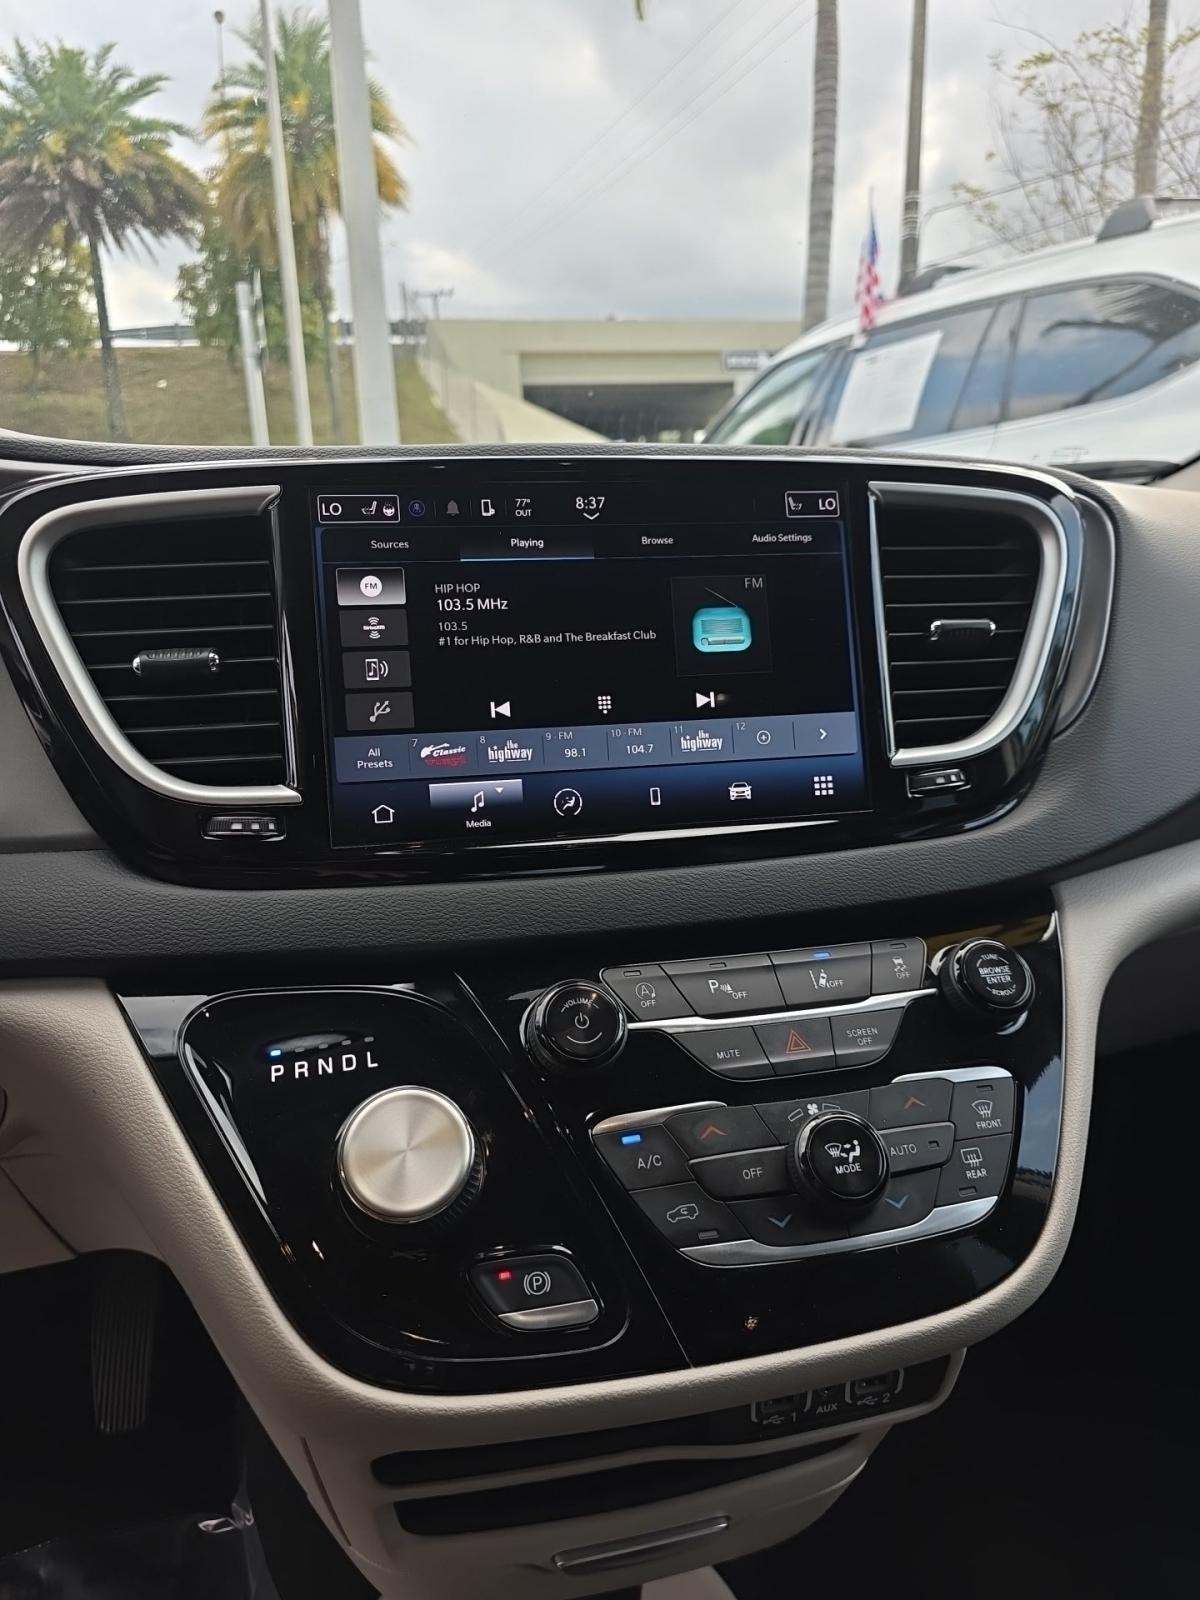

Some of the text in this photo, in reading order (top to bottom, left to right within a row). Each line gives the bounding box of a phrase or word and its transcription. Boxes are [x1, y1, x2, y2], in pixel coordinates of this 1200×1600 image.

[575, 496, 605, 509] 8:37
[818, 498, 836, 511] LO
[321, 502, 342, 516] LO
[515, 508, 532, 517] OUT
[510, 538, 544, 549] Playing
[641, 536, 674, 545] Browse
[752, 533, 813, 544] Audio Settings
[371, 540, 409, 549] Sources
[364, 582, 378, 590] FM
[434, 583, 481, 594] HIP HOP
[744, 578, 763, 589] FM
[437, 597, 509, 611] 103.5 MHz
[438, 621, 468, 631] 103.5
[439, 630, 657, 648] #1 for Hip Hop, R&B and The Breakfast Club
[674, 725, 684, 733] 11
[735, 722, 746, 731] 12
[545, 731, 573, 741] 9 FM
[611, 727, 642, 737] 10 FM
[411, 738, 418, 748] 7
[480, 736, 486, 744] 8
[507, 740, 518, 750] the
[680, 735, 723, 752] highway
[367, 748, 381, 757] All
[433, 745, 466, 757] Classic
[488, 746, 533, 762] highway
[564, 748, 587, 758] 98.1
[626, 744, 654, 754] 104.7
[357, 759, 393, 769] Presets
[466, 819, 492, 828] Media
[895, 970, 911, 980] OFF
[978, 965, 1011, 975] BROWSE
[829, 979, 845, 988] OFF
[986, 975, 1012, 985] ENTER
[731, 991, 749, 1000] OFF
[640, 999, 657, 1008] OFF
[846, 1027, 878, 1038] SCREEN
[857, 1036, 873, 1046] OFF
[716, 1050, 741, 1060] MUTE
[975, 1118, 1002, 1130] FRONT
[890, 1143, 917, 1156] AUTO
[637, 1154, 663, 1169] A/C
[742, 1167, 763, 1180] OFF
[834, 1163, 862, 1175] MODE
[966, 1168, 988, 1180] REAR
[816, 1403, 838, 1415] AUX
